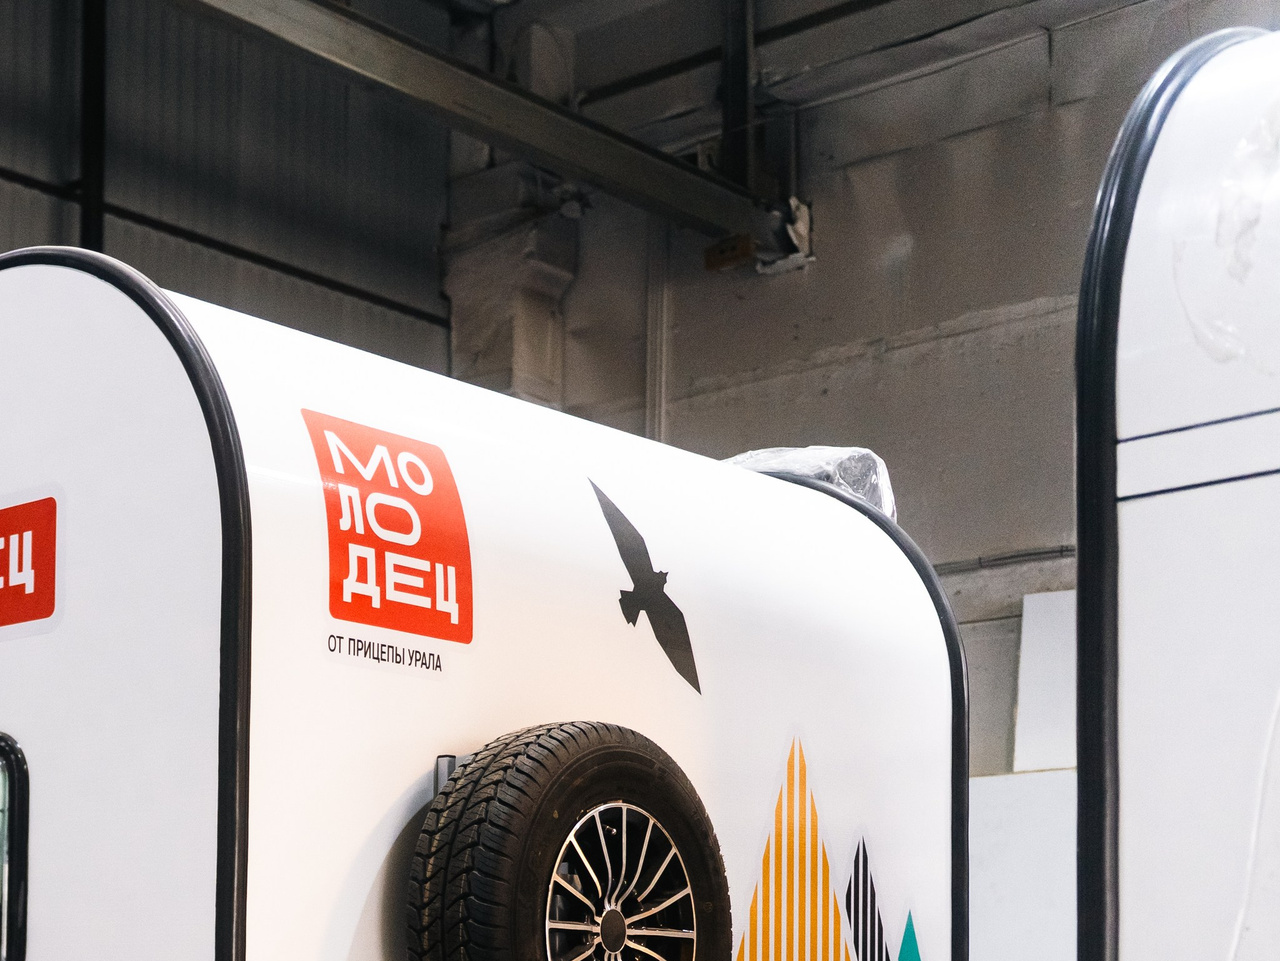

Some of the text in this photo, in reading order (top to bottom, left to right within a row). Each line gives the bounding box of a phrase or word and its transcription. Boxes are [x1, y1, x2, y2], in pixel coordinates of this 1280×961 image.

[337, 483, 422, 546] ЛО
[342, 543, 459, 625] ДЕЦ
[327, 634, 442, 671] ОТ ПРИЦЕПЫ УРАЛА
